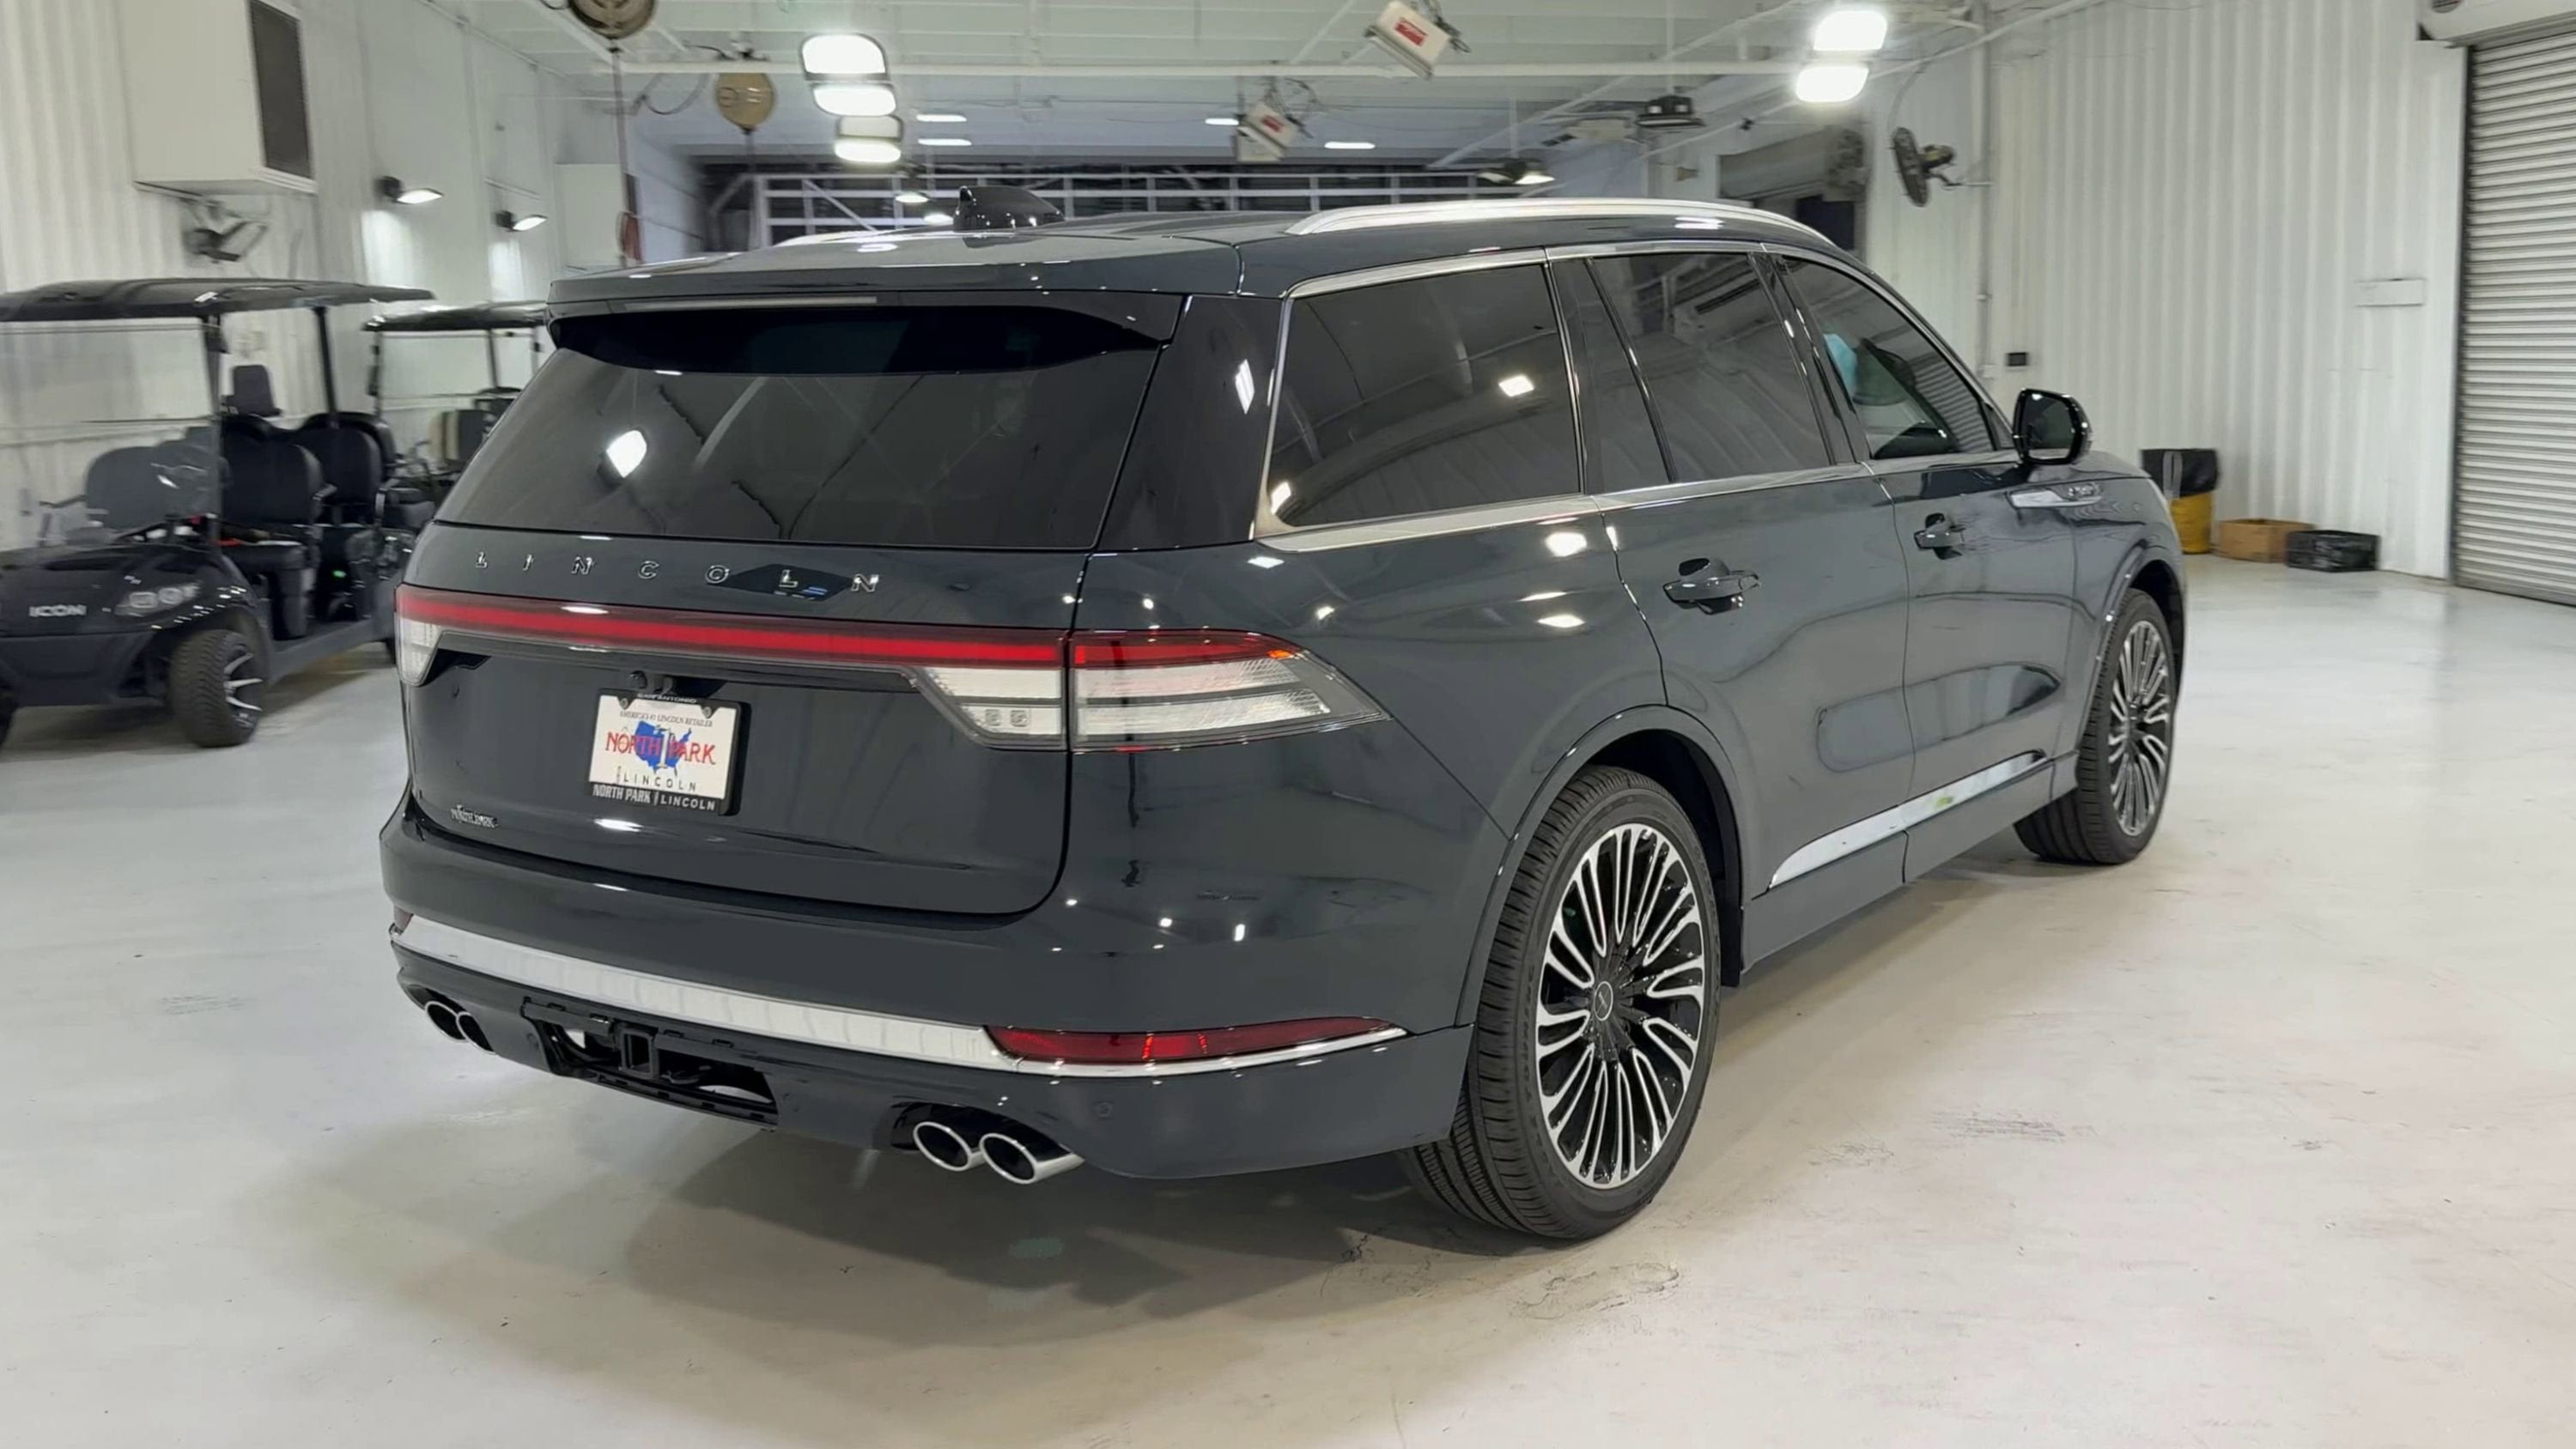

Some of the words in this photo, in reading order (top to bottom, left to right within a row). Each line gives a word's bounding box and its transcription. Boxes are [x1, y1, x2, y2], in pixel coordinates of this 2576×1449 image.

[474, 551, 880, 593] LINCOLN
[28, 604, 87, 617] ICON
[605, 731, 660, 756] NORTH
[667, 738, 716, 765] PARK
[623, 775, 697, 791] LINCOLN
[592, 784, 624, 800] NORTH
[624, 788, 651, 803] PARK
[660, 794, 715, 811] LINCOLN
